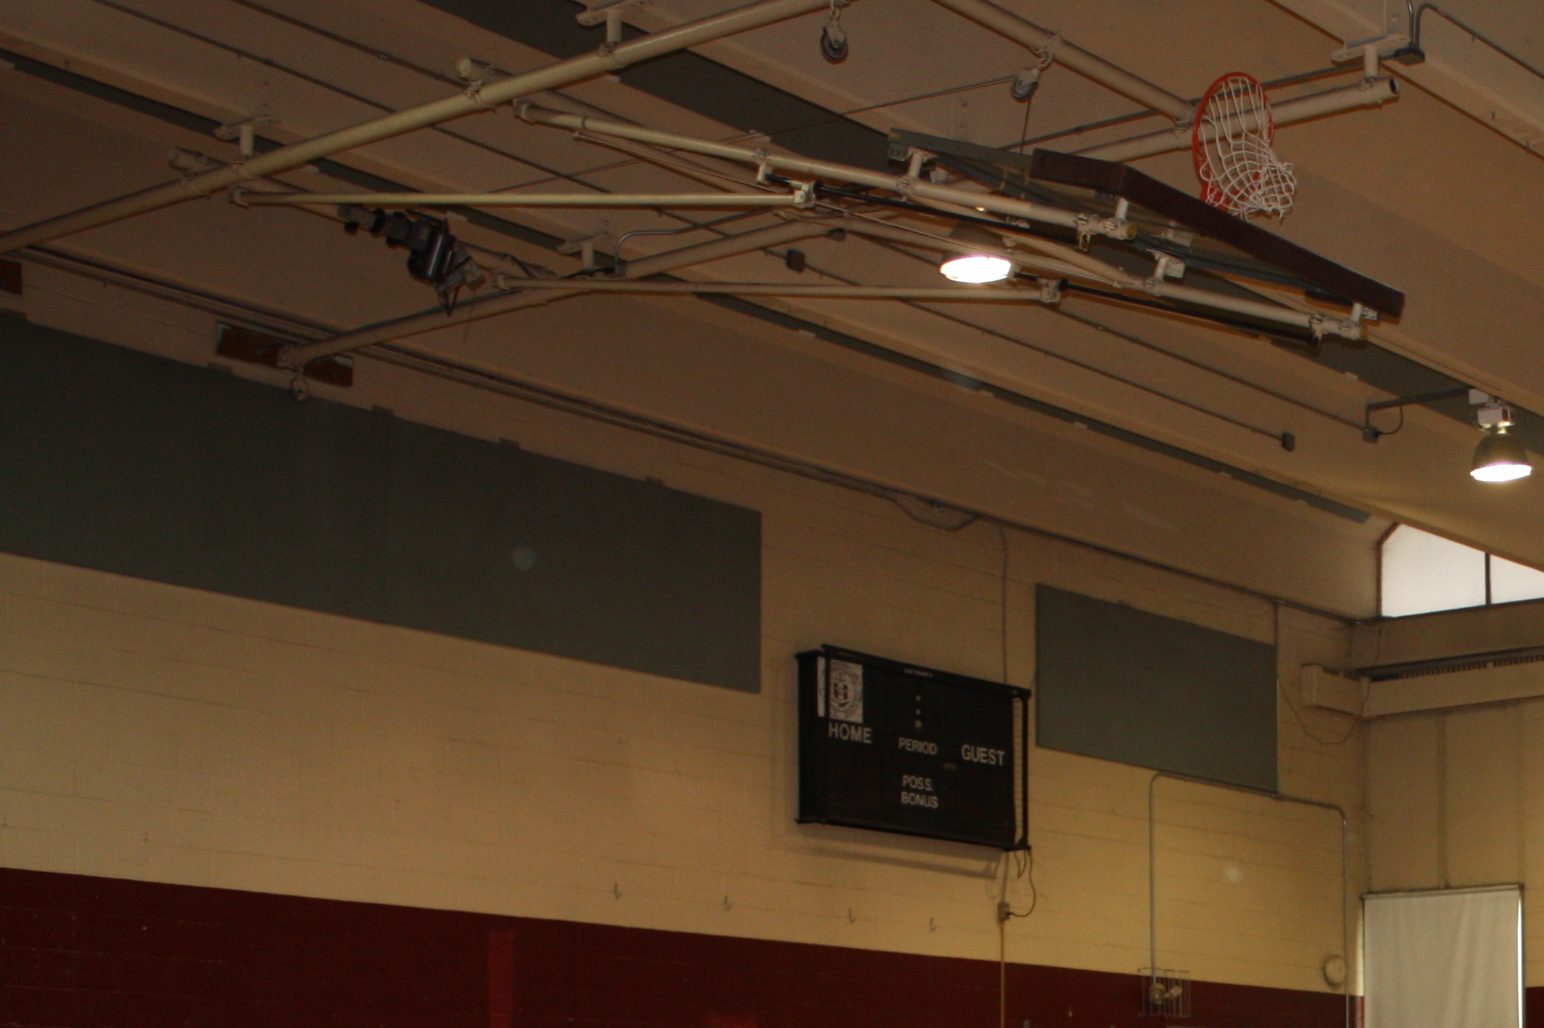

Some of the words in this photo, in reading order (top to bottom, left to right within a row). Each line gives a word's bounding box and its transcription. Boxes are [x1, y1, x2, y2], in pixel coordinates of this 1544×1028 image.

[828, 722, 873, 744] HOME
[898, 737, 938, 755] PERIOD
[961, 744, 1006, 766] GUEST
[901, 791, 939, 808] BONUS
